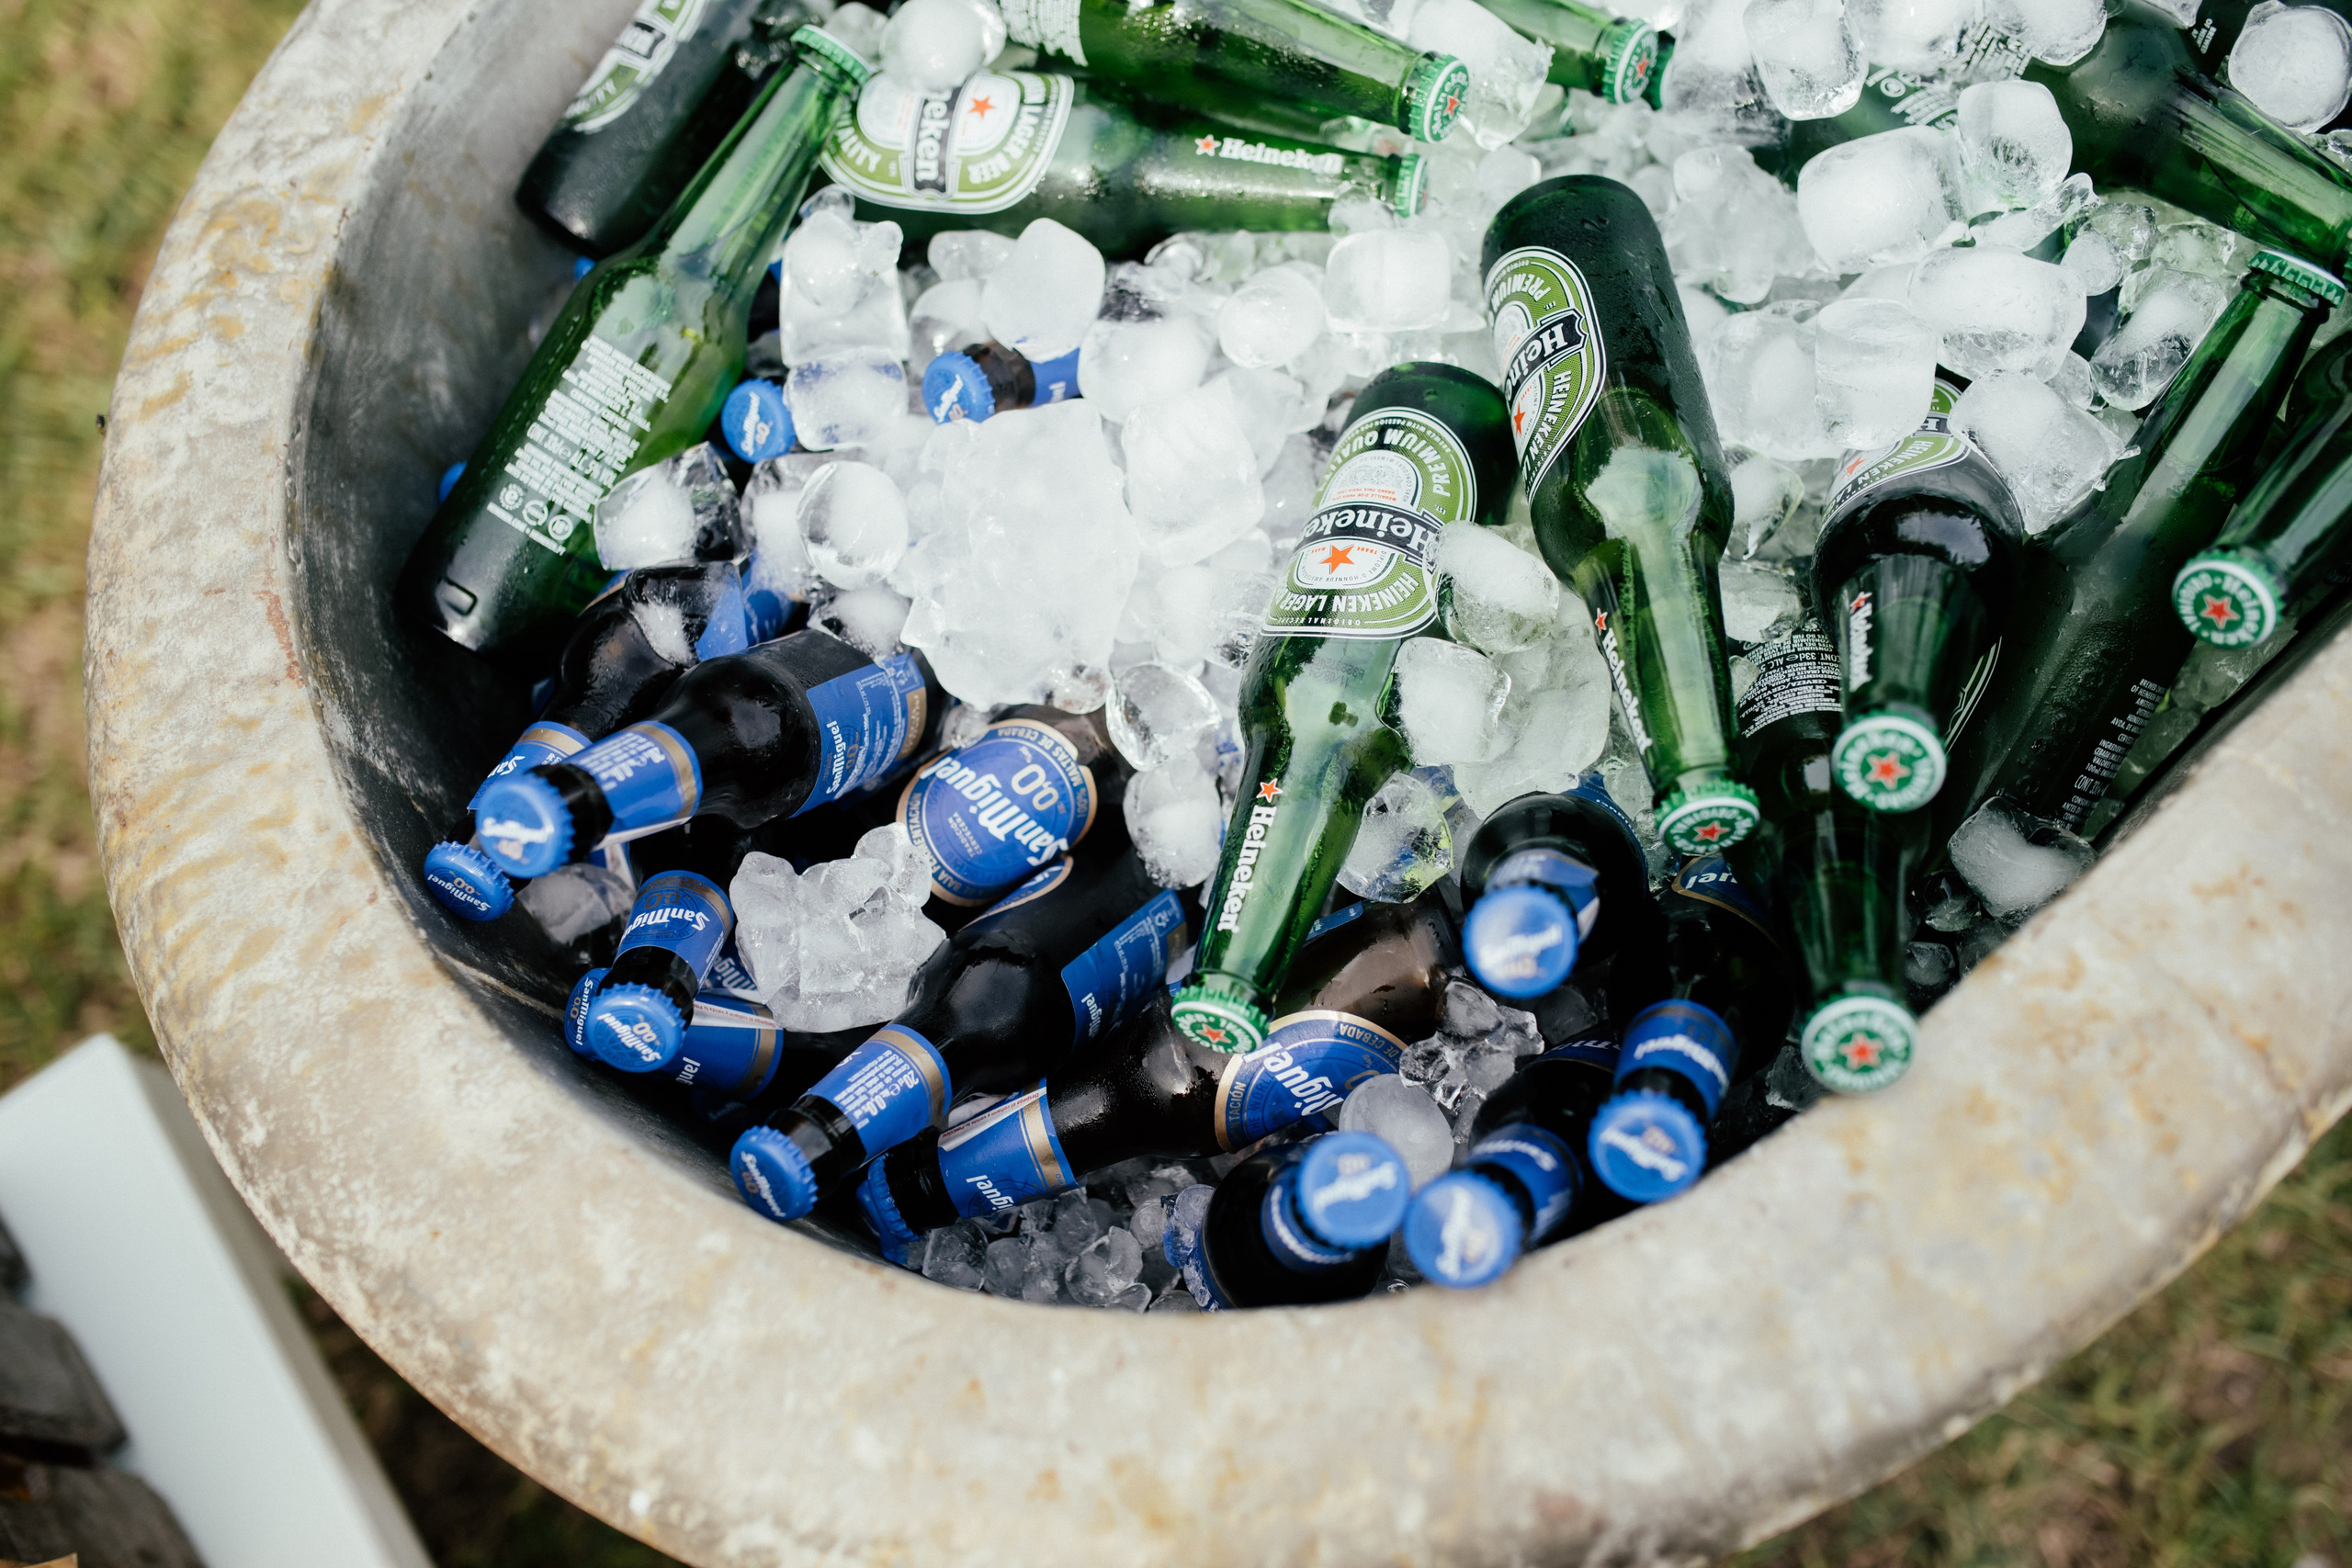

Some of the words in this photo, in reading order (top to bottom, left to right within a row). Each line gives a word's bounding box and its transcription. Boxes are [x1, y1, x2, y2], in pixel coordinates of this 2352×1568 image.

[916, 89, 953, 182] neken
[1488, 271, 1552, 312] PREMIUM
[1503, 322, 1567, 403] Heine
[1528, 370, 1570, 460] HEINEKEN
[1384, 427, 1451, 497] PREMIUM
[1857, 439, 1934, 485] HEINEKEN
[1301, 508, 1431, 556] Heineke
[1331, 571, 1419, 612] HEINEKEN
[1601, 626, 1654, 756] Heineken
[826, 720, 846, 795] SanMiguel
[998, 728, 1042, 746] CEBADA
[1037, 736, 1054, 750] DE
[1012, 763, 1059, 811] 0,0
[1051, 748, 1085, 787] MALTAS
[920, 756, 1069, 867] SanMiguel
[427, 874, 492, 912] SanMiguel
[937, 869, 963, 892] BAJA
[1217, 804, 1277, 934] Heineken
[574, 977, 594, 1046] SanMiguel
[596, 1012, 662, 1064] SanMiguel
[1340, 1022, 1385, 1050] CEBADA
